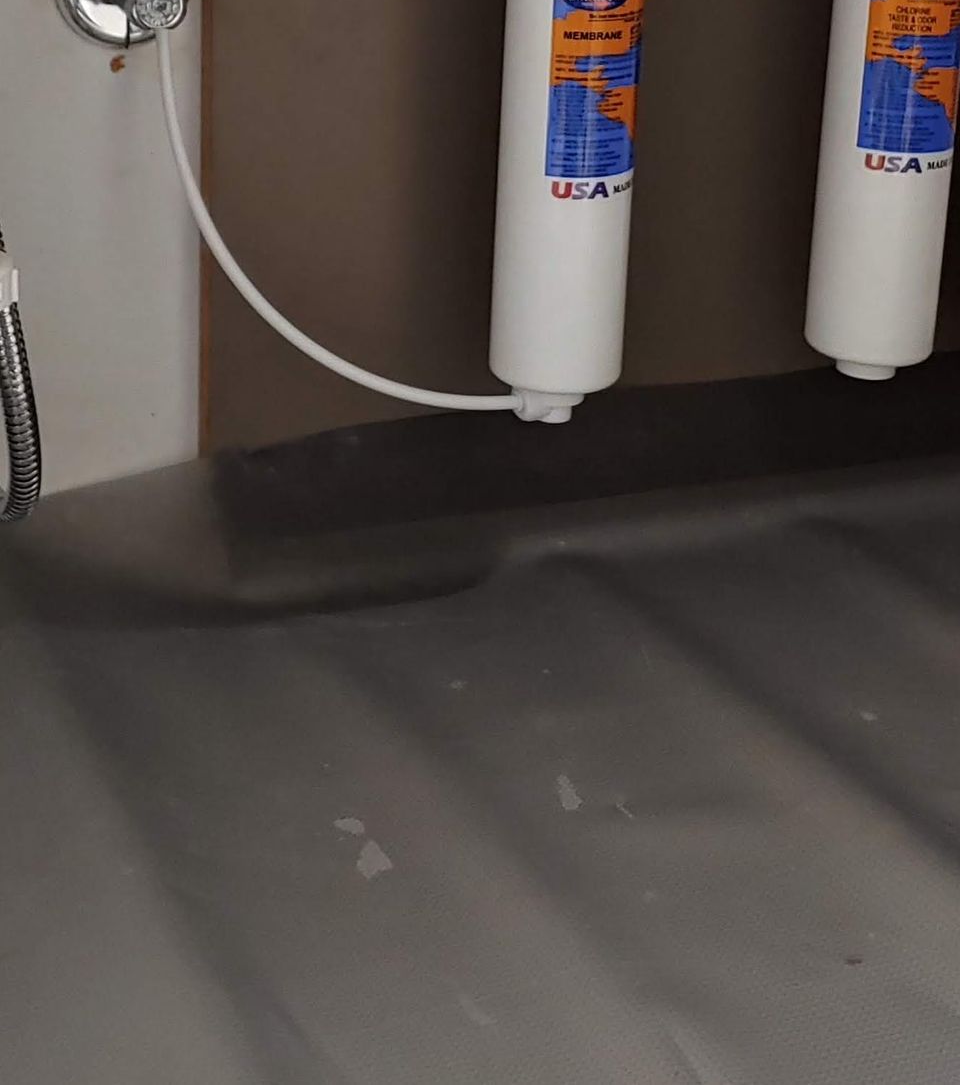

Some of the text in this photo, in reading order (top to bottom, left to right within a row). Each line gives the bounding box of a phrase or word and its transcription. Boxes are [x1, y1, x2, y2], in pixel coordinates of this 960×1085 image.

[896, 5, 931, 16] CHLORINE
[888, 13, 909, 23] TASTE
[918, 15, 937, 24] ODOR
[892, 22, 932, 33] REDUCTION
[563, 31, 623, 41] MEMBRANE
[864, 153, 923, 174] USA
[551, 181, 609, 200] USA
